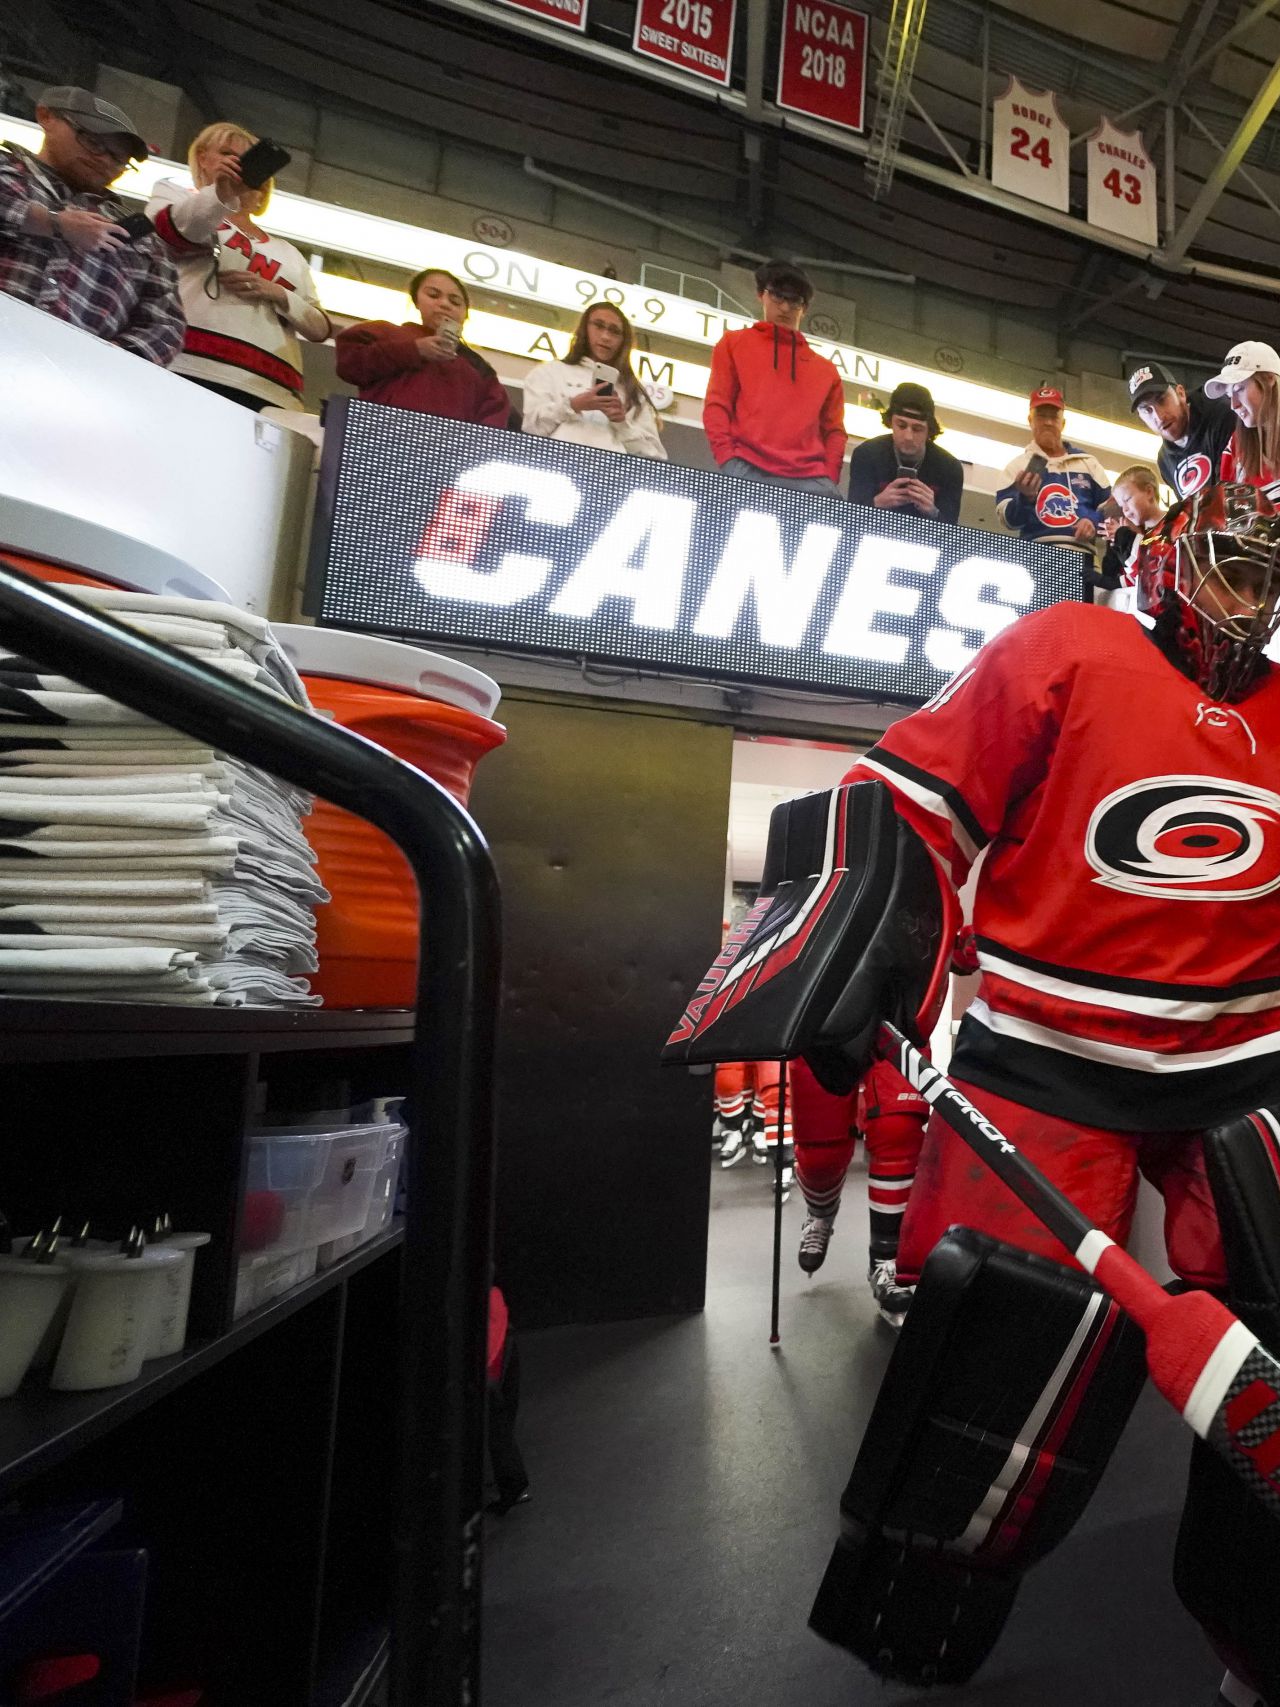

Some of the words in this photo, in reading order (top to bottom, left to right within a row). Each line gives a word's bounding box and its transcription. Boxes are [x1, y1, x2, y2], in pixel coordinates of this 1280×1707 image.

[546, 0, 582, 15] OUND
[660, 0, 713, 40] 2015
[795, 5, 855, 50] NCAA
[641, 24, 680, 54] SWEET
[681, 43, 726, 72] SIXTEEN
[801, 45, 846, 89] 2018
[1009, 126, 1054, 169] 24
[1098, 140, 1147, 171] CHARLES
[1102, 167, 1143, 206] 43
[463, 250, 540, 294] ON
[413, 460, 1035, 674] CANES
[666, 896, 775, 1046] VAUGHN
[944, 1088, 1017, 1155] PRO+
